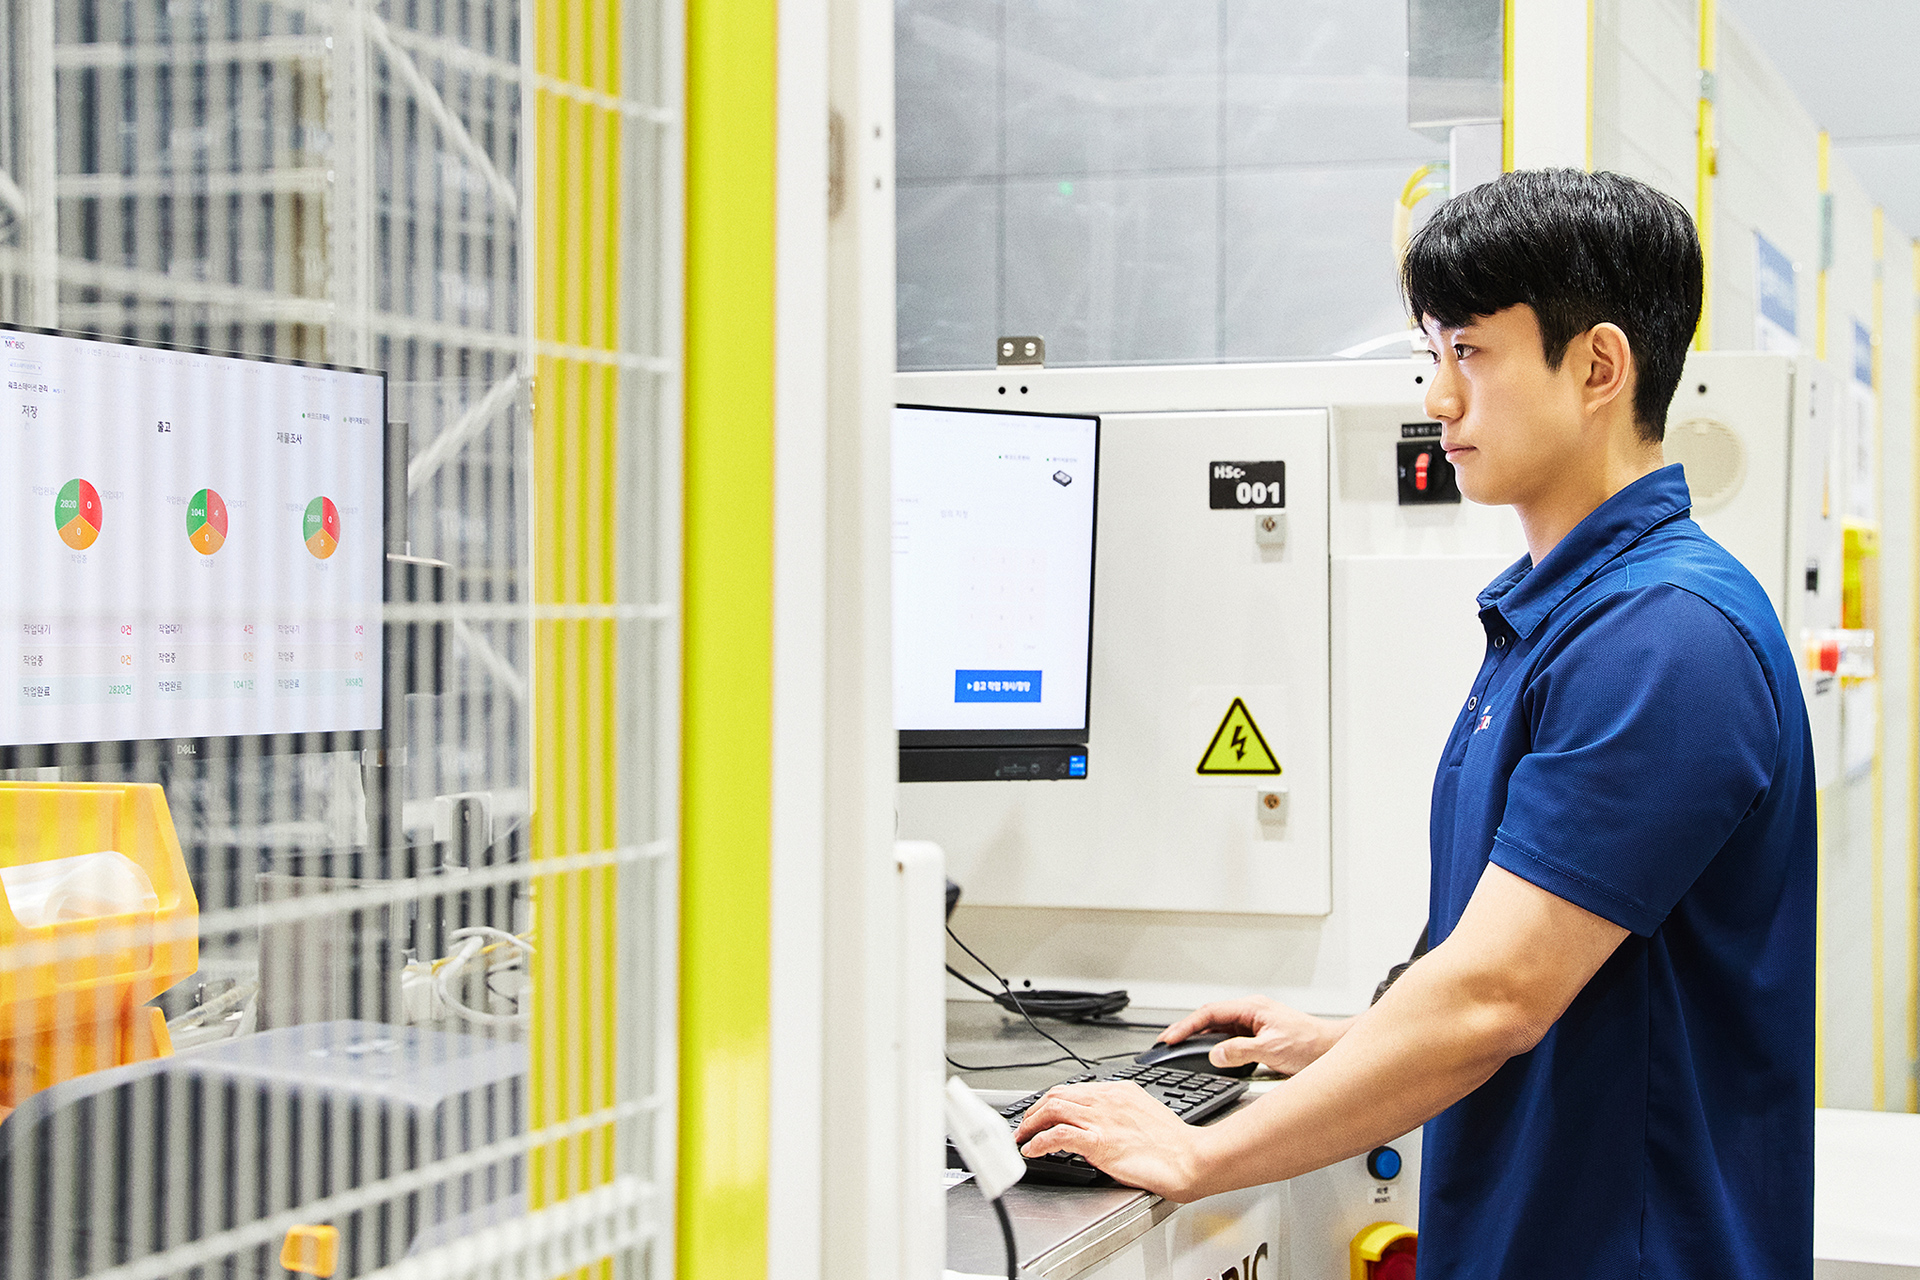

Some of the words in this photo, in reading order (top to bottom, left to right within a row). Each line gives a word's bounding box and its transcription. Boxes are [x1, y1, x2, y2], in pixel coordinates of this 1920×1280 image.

[4, 340, 25, 350] MOBIS
[38, 384, 48, 393] 관리
[22, 404, 38, 419] 저장
[157, 421, 171, 432] 출고
[276, 432, 302, 444] 재물조사
[1214, 465, 1246, 479] HSc-
[1236, 481, 1280, 504] 001
[60, 499, 77, 508] 2820
[87, 501, 92, 509] 0
[191, 508, 205, 517] 1041
[76, 527, 82, 536] 0
[204, 534, 210, 542] 0
[23, 624, 51, 635] 작업대기
[120, 625, 132, 635] 0건
[158, 624, 183, 634] 작업대기
[244, 624, 254, 634] 4건
[278, 625, 300, 634] 작업대기
[355, 625, 364, 635] 0건
[22, 655, 44, 666] 작업중
[120, 655, 132, 665] 0건
[158, 652, 176, 663] 작업중
[243, 652, 254, 662] 0건
[278, 652, 294, 662] 작업중
[354, 651, 364, 661] 0건
[158, 681, 182, 692] 작업완료
[233, 680, 254, 690] 1041건
[278, 679, 300, 689] 작업완료
[22, 686, 50, 697] 작업완료
[108, 685, 132, 695] 2820건
[177, 744, 196, 755] DELL
